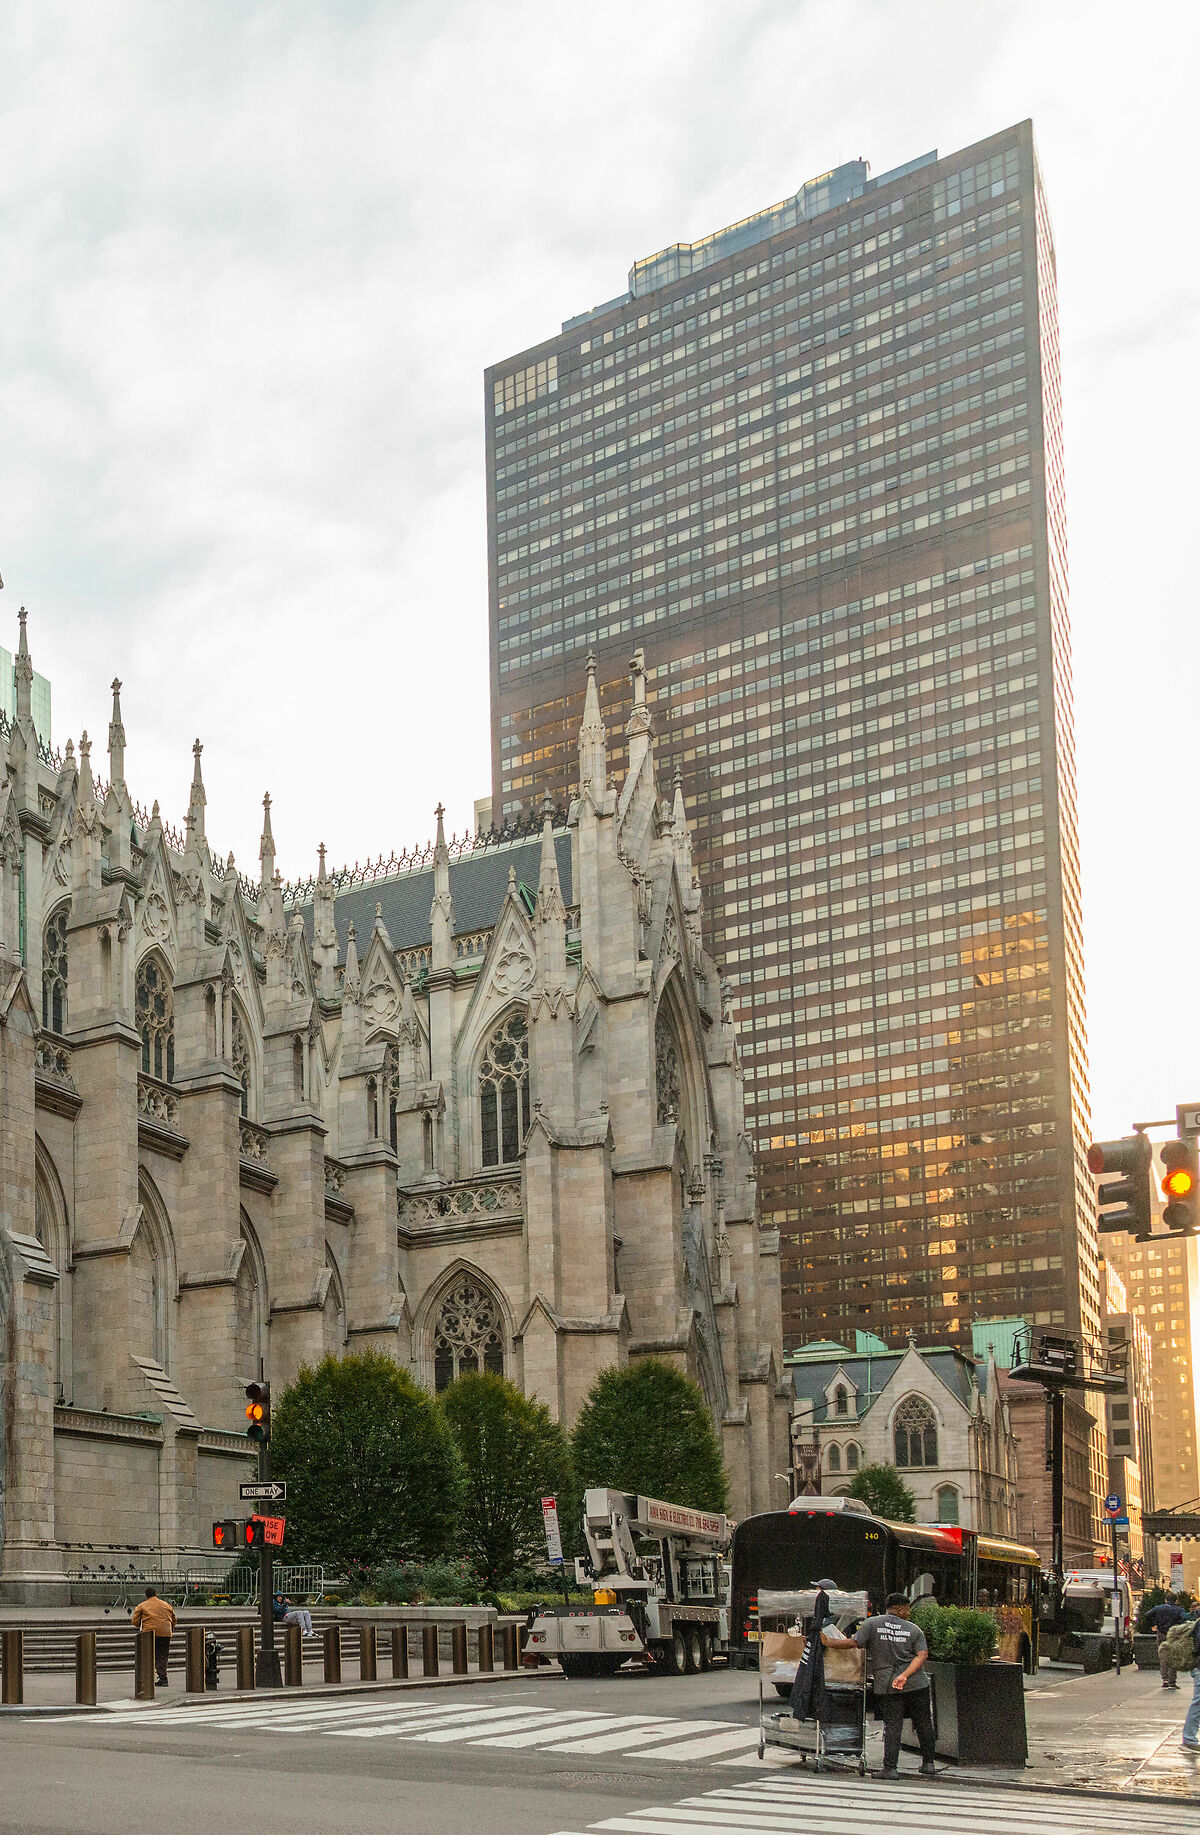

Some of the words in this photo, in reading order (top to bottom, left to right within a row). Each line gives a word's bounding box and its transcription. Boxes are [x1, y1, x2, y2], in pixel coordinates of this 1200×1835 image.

[659, 1508, 669, 1522] SIGN
[265, 1531, 277, 1540] OW
[865, 1532, 879, 1540] 240
